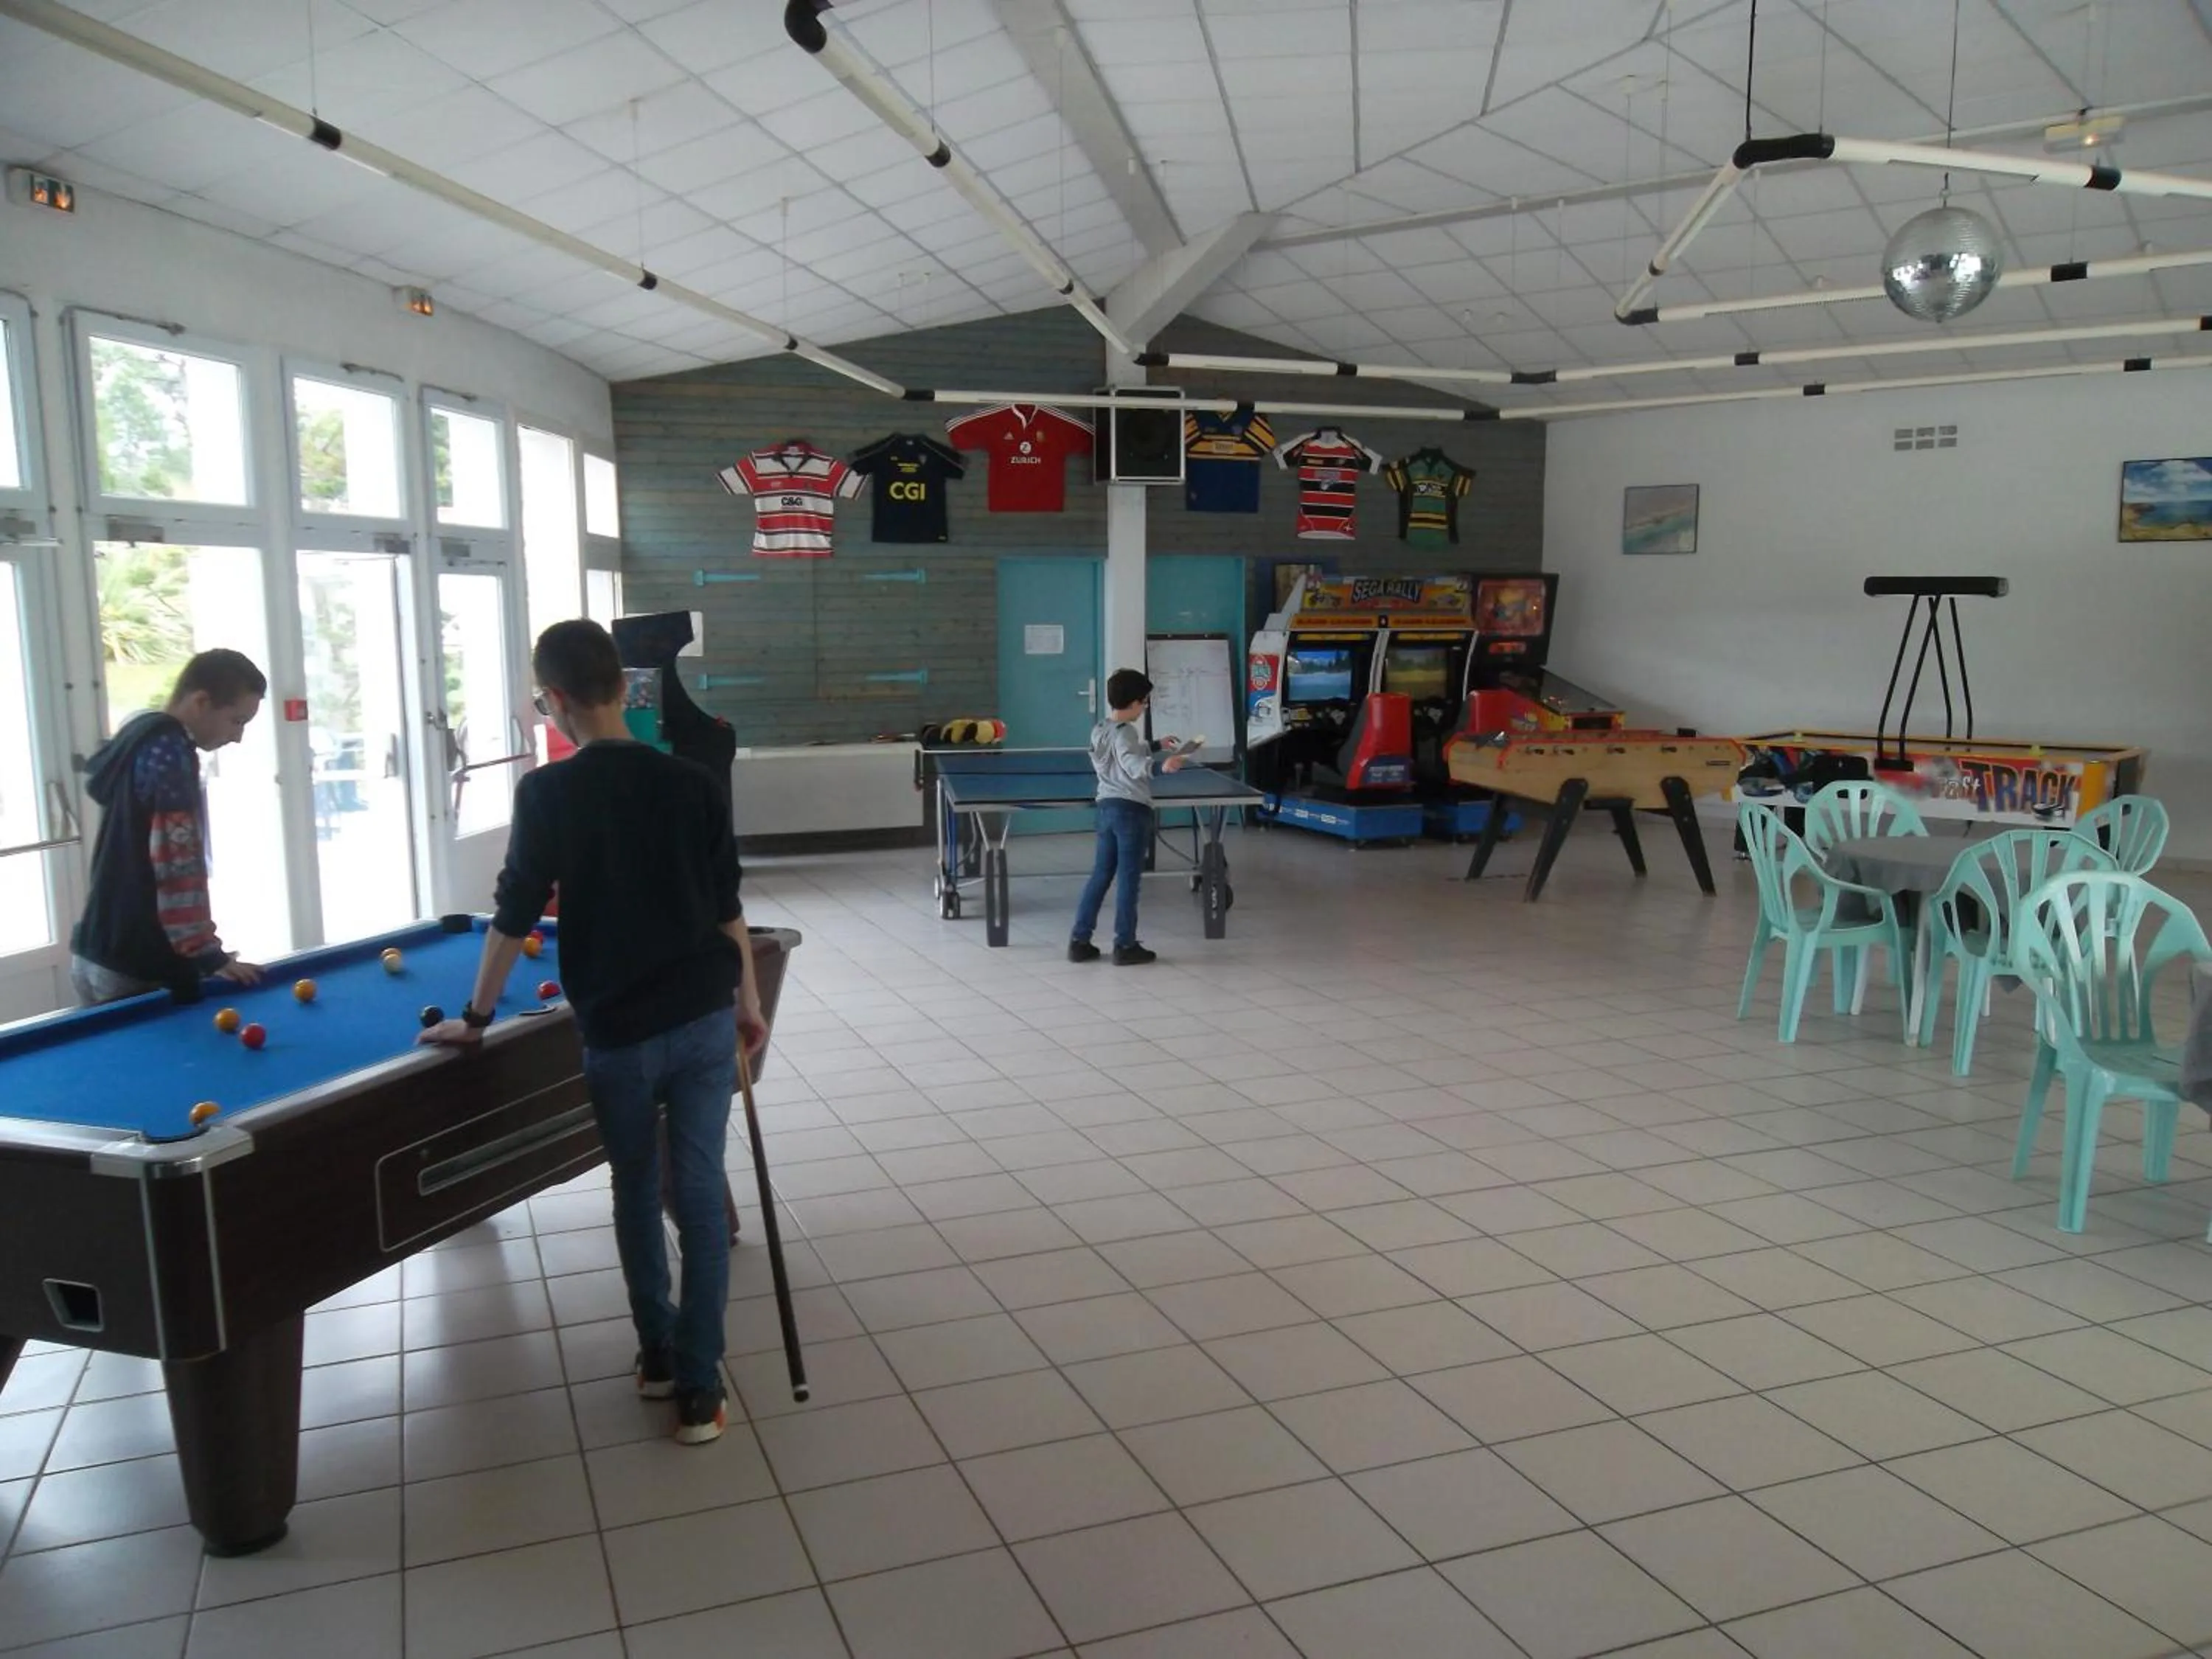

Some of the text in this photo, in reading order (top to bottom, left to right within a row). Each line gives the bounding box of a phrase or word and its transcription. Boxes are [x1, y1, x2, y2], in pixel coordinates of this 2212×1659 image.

[889, 481, 925, 500] CGI
[782, 497, 802, 507] C&G
[1352, 580, 1422, 602] SEGA RALLY
[1959, 759, 2076, 812] TRACK
